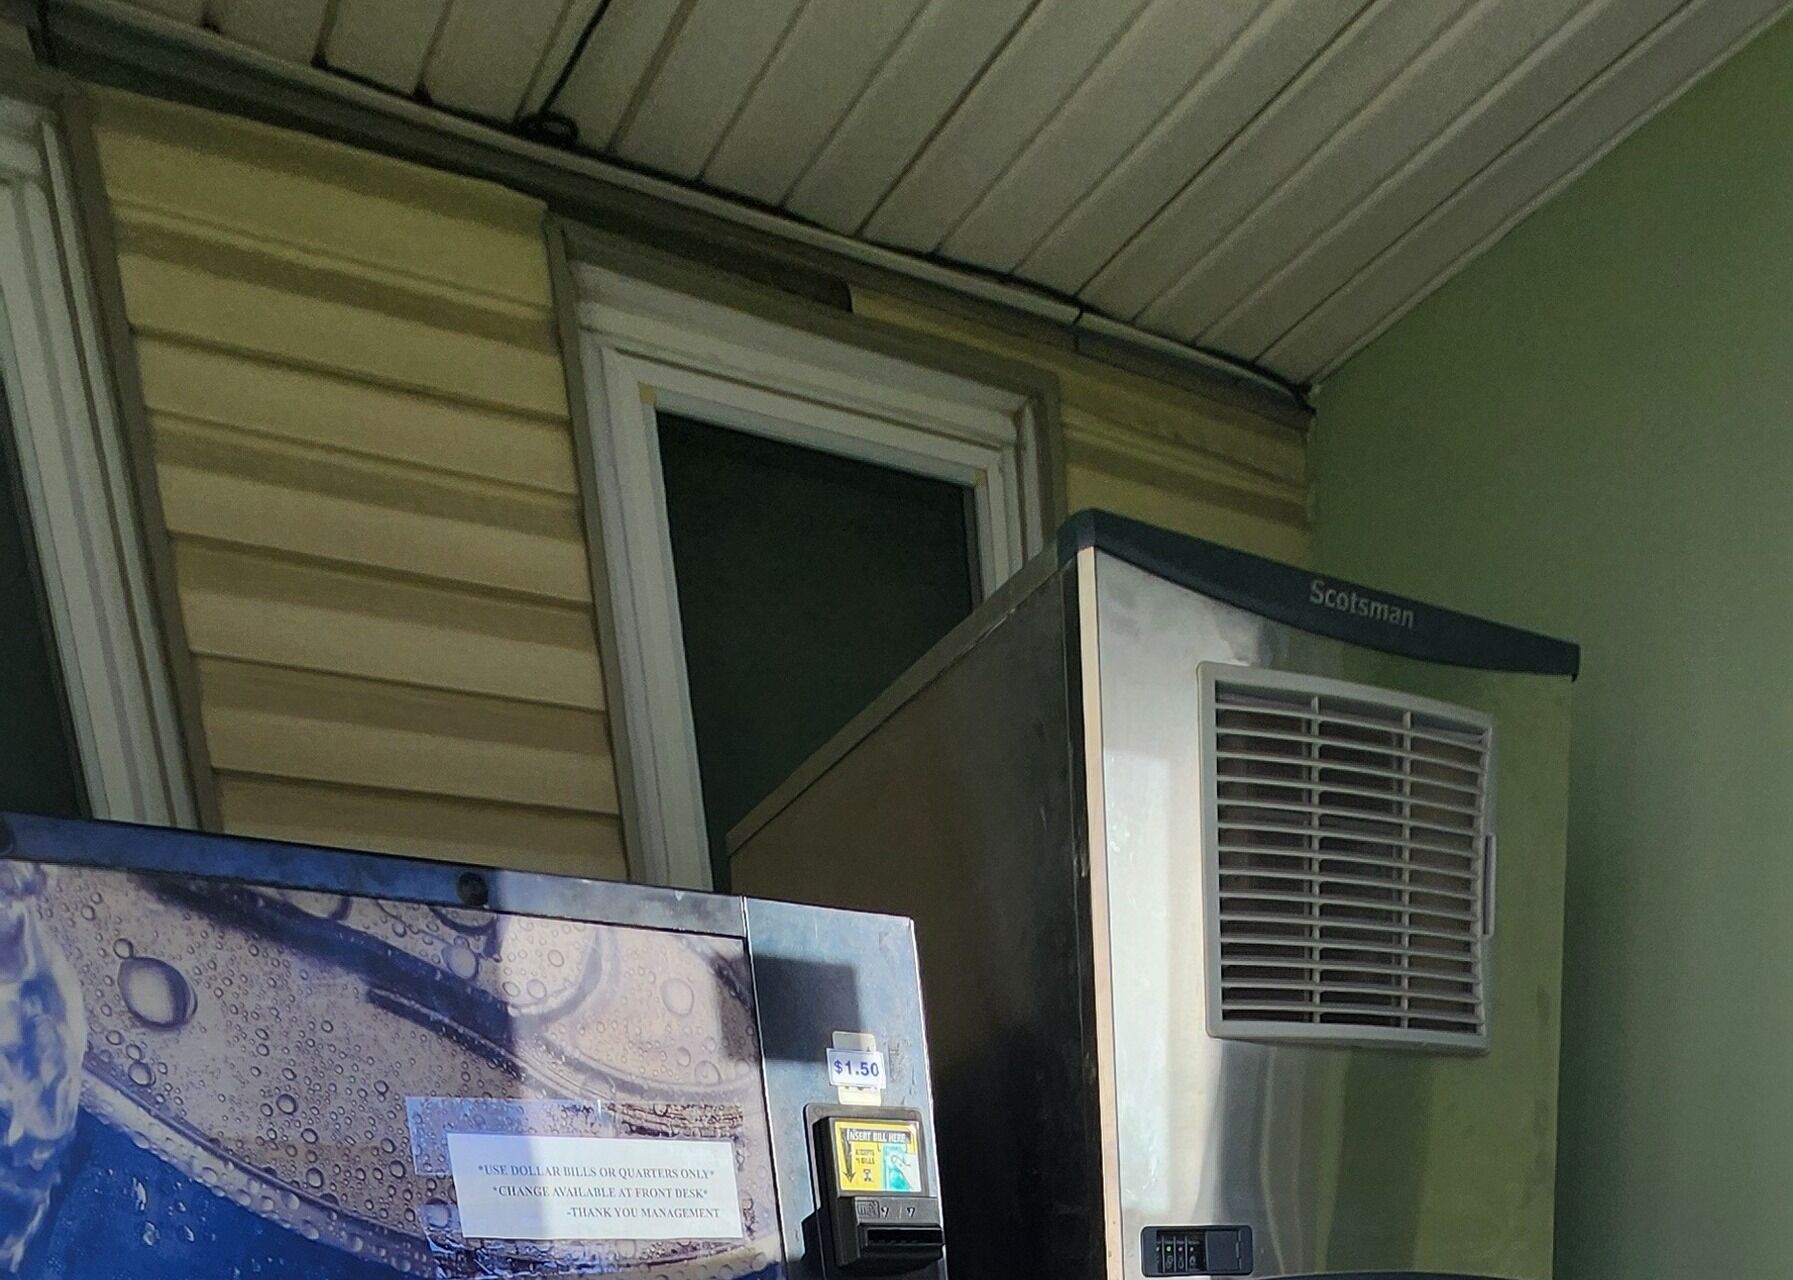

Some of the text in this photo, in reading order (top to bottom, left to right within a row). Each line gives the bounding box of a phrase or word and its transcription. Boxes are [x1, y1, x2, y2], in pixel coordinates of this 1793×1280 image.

[1309, 580, 1415, 630] Scotsman
[834, 1059, 880, 1077] $1.50
[846, 1128, 871, 1141] INSERT
[873, 1130, 887, 1142] BILL
[510, 1165, 561, 1177] DOLLAR
[563, 1166, 597, 1177] BILLS
[599, 1167, 617, 1178] OR
[619, 1167, 679, 1180] QUARTERS
[553, 1186, 616, 1198] AVAILABLE
[619, 1187, 633, 1198] AT
[635, 1187, 672, 1198] FRONT
[567, 1207, 720, 1219] -THANK YOU MANAGEMENT
